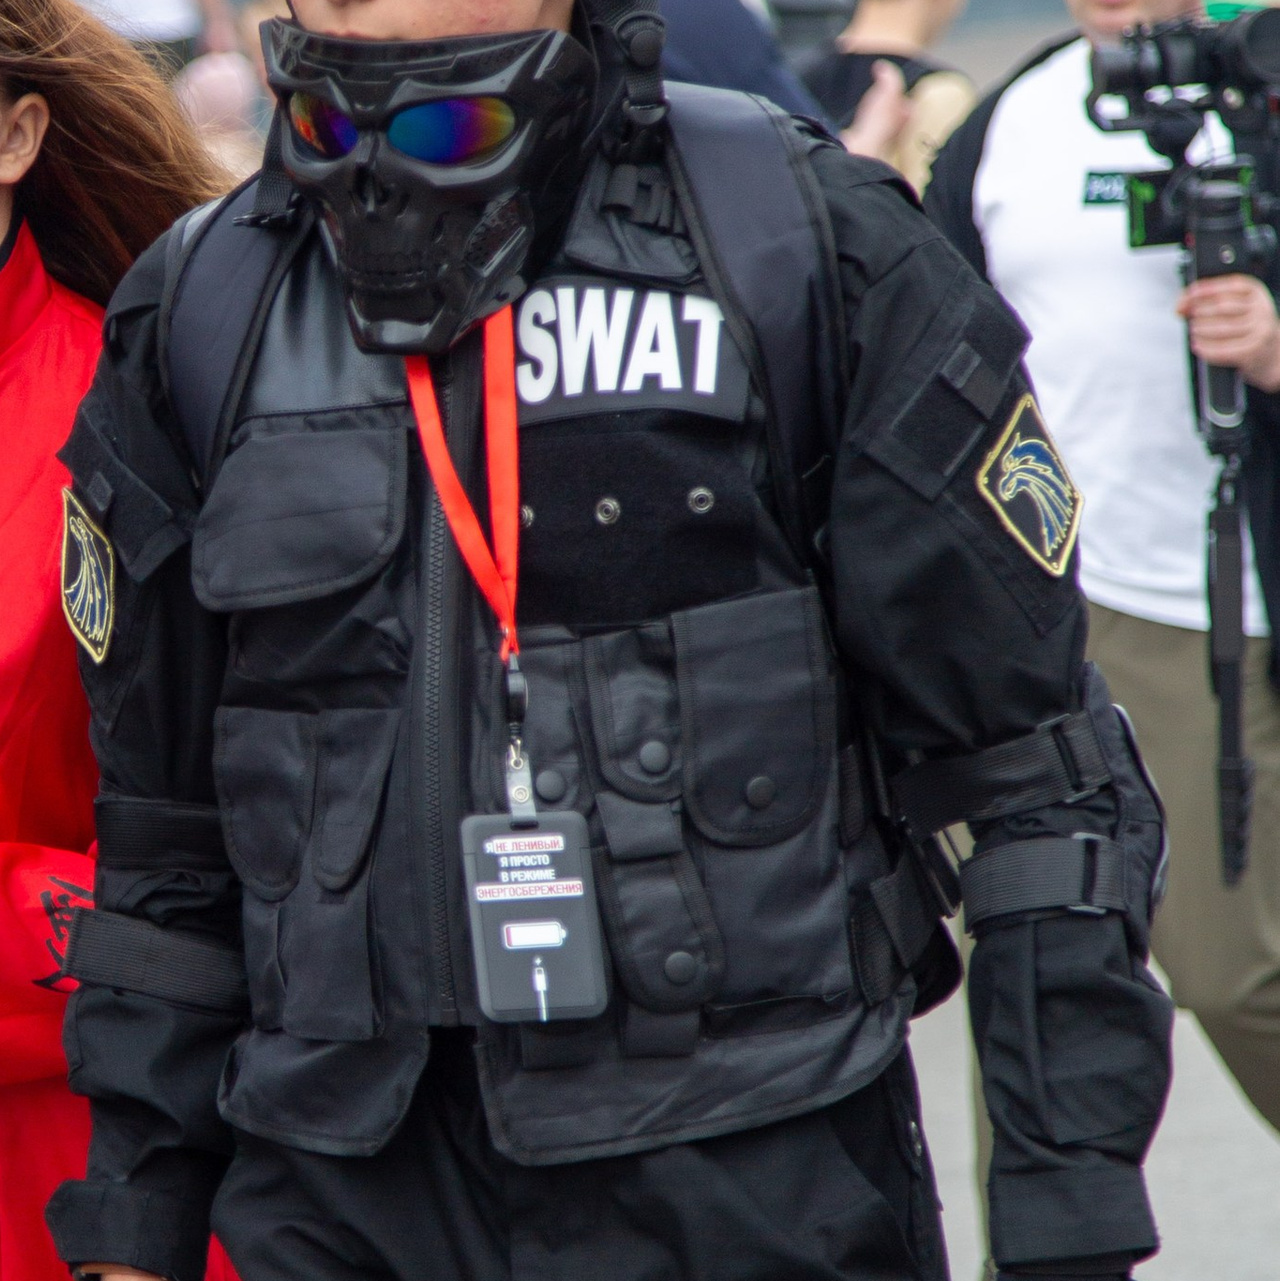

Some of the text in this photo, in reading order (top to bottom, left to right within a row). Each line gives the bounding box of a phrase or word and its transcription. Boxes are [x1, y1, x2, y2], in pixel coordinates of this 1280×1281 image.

[517, 287, 724, 403] SWAT
[485, 841, 494, 853] Я
[495, 840, 510, 852] НЕ
[500, 855, 550, 867] Я ПРОСТО
[501, 869, 556, 882] В РЕЖИМЕ
[477, 883, 583, 899] ЭНЕРГОСБЕРЕЖЕНИЯ
